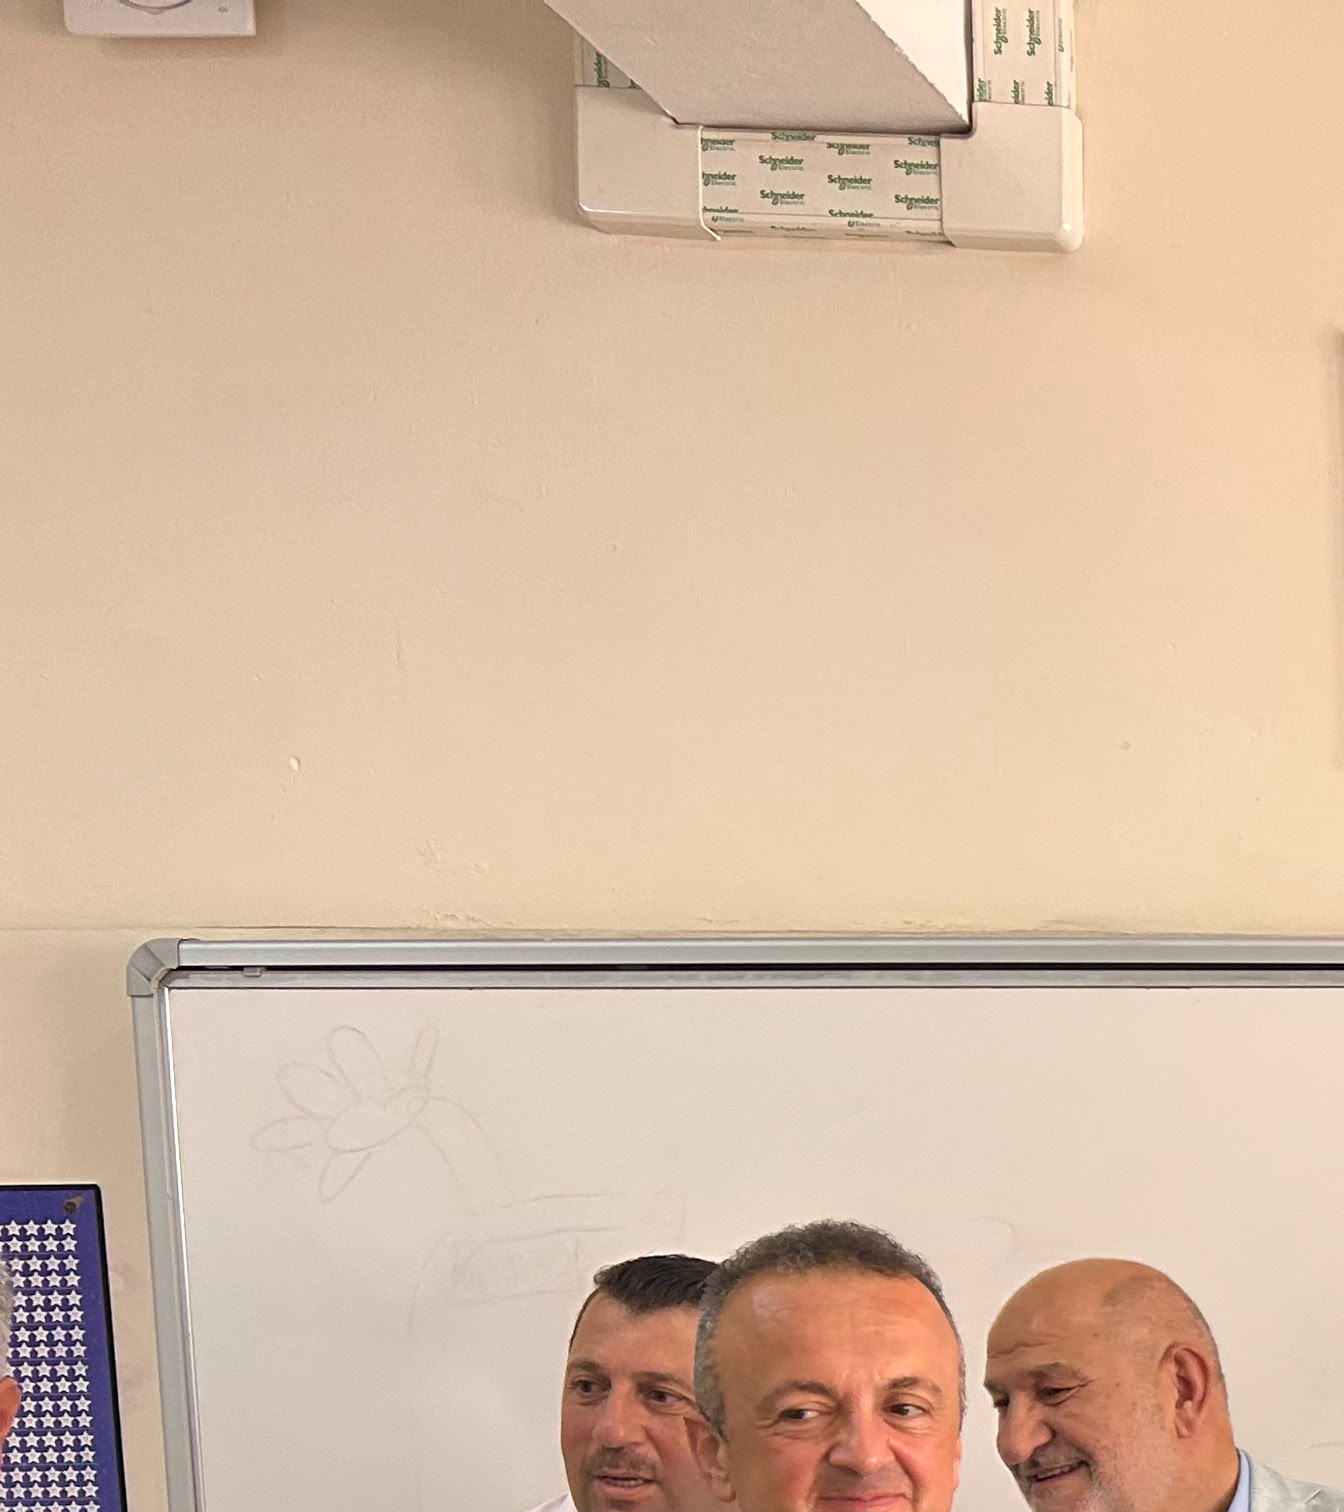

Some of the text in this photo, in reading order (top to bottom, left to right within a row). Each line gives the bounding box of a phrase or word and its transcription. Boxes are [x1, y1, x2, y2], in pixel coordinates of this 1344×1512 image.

[993, 7, 1008, 55] Schneider
[1026, 8, 1041, 56] Schneider
[759, 155, 804, 171] Schneider
[894, 160, 938, 176] Schneider
[702, 172, 737, 186] hneider
[827, 175, 872, 190] Schneider
[760, 190, 805, 205] Schneider
[894, 195, 939, 210] Schneider
